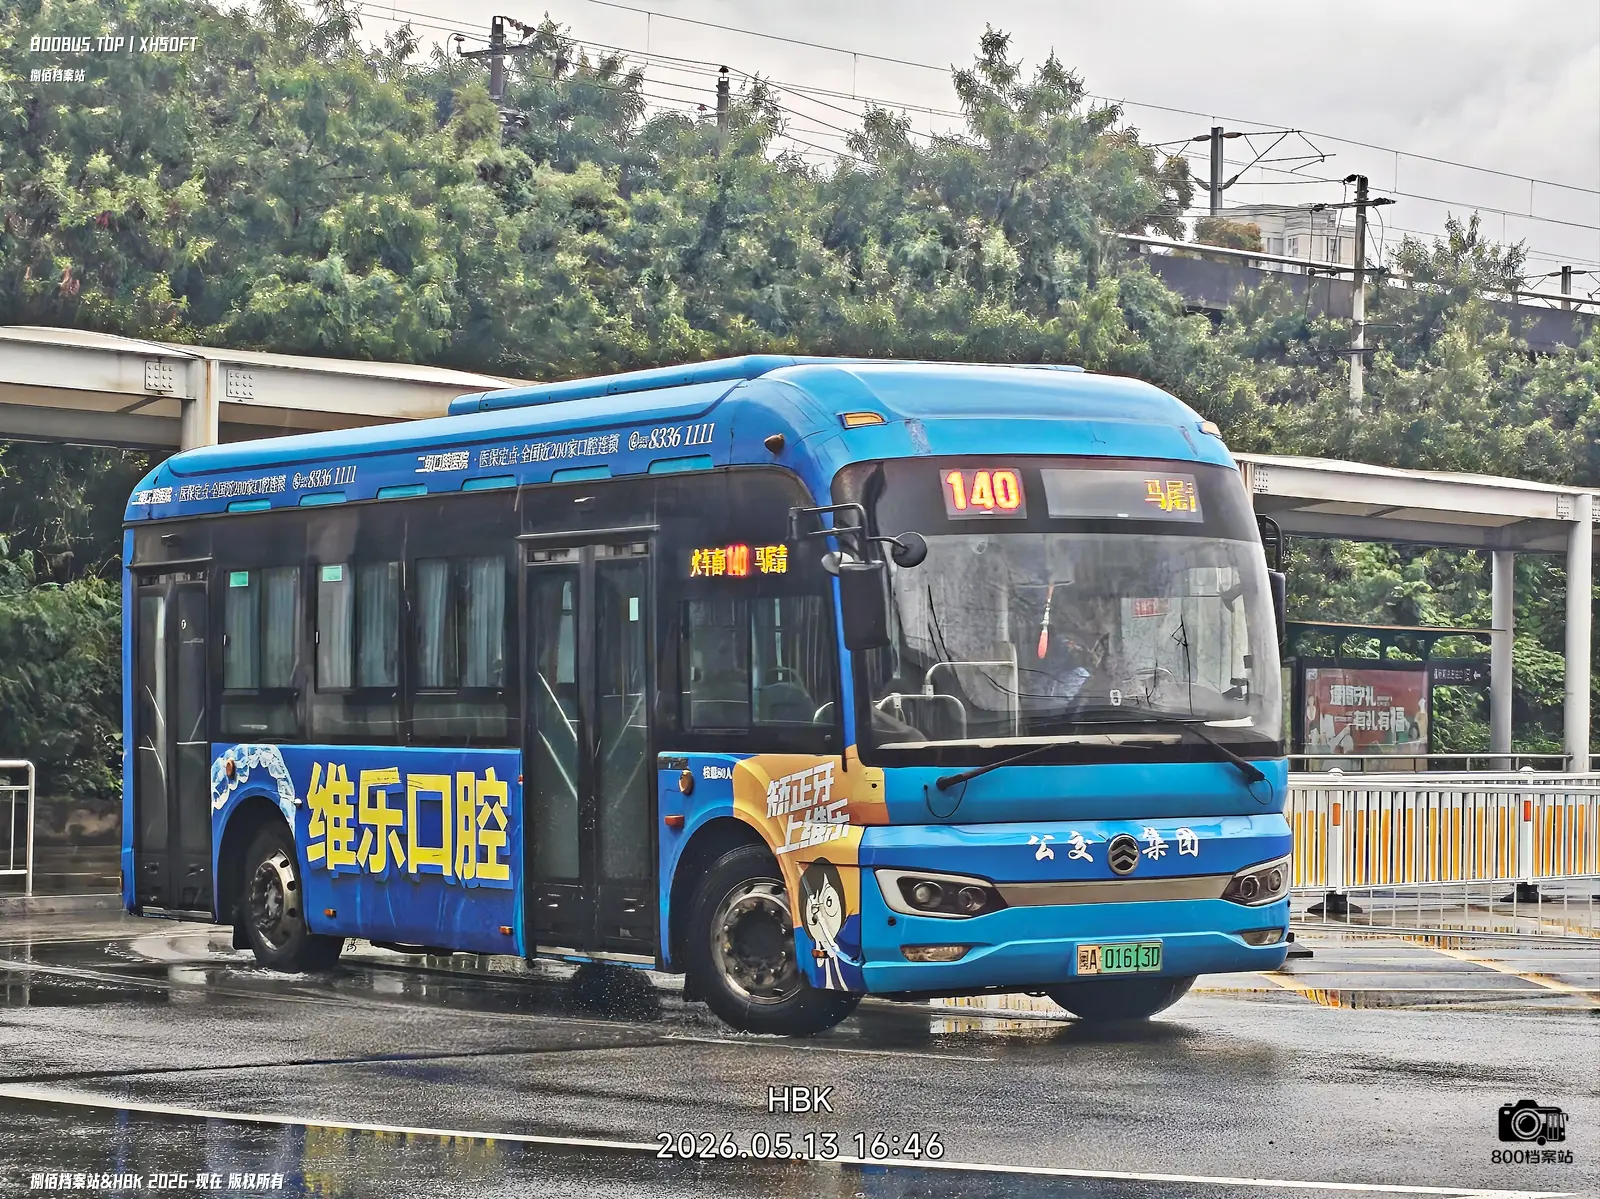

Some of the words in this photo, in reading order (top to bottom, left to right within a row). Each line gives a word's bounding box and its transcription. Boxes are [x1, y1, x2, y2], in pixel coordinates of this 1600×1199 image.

[648, 426, 683, 449] 8336
[684, 423, 715, 446] 1111
[946, 470, 1021, 511] 140
[306, 762, 511, 882] 维乐口腔
[776, 798, 851, 855] 上维乐
[1028, 830, 1094, 863] 公交
[1142, 826, 1199, 861] 集团
[1105, 946, 1160, 969] 01613D
